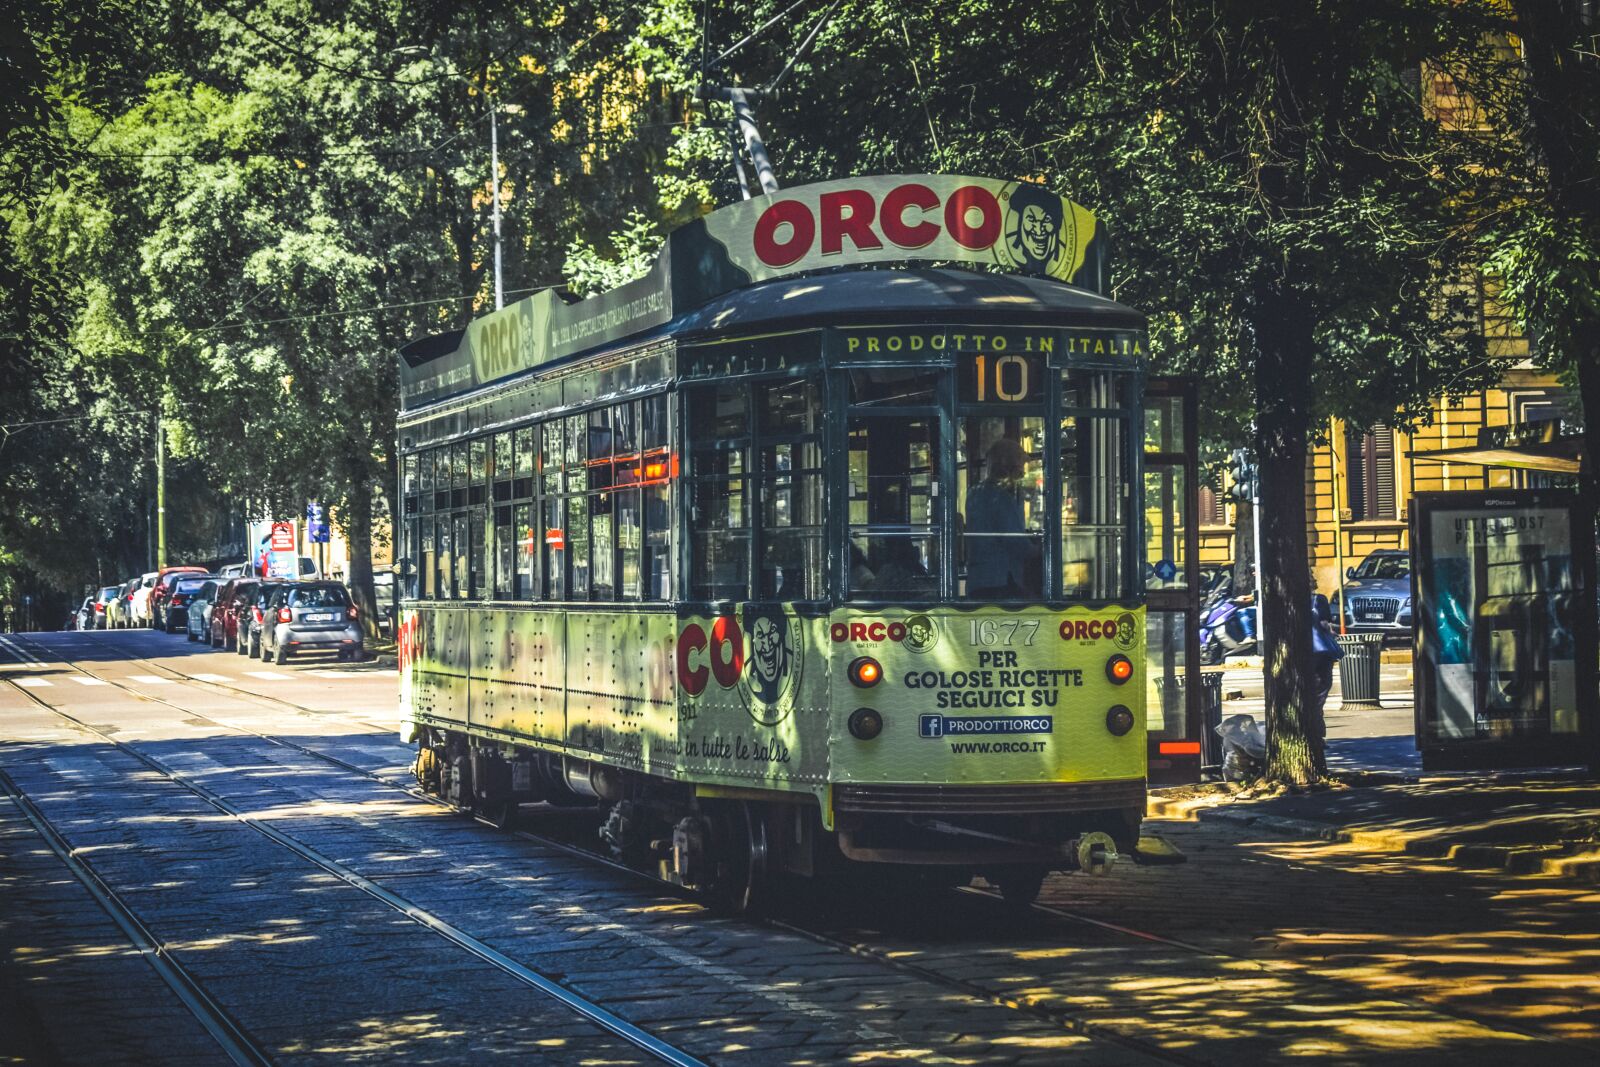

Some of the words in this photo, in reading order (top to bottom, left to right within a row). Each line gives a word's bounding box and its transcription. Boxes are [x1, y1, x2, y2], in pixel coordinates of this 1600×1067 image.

[753, 183, 1002, 269] ORCO
[579, 312, 607, 338] SPECIALISTA
[607, 304, 631, 329] ITALIANO
[632, 297, 647, 319] DELLE
[647, 291, 664, 313] SALSE
[480, 312, 520, 378] ORCO
[848, 335, 1008, 353] PRODOTTO
[1025, 336, 1053, 352] IN
[1069, 338, 1143, 355] ITALIA
[975, 355, 1029, 401] 10
[830, 621, 907, 643] ORCO
[969, 619, 1040, 646] 1677
[1059, 620, 1117, 640] ORCO
[978, 650, 1018, 667] PER
[904, 671, 993, 689] GOLOSE
[999, 670, 1083, 687] RICETTE
[937, 690, 1025, 708] SEGUICI
[1031, 690, 1059, 706] SU
[949, 719, 1050, 731] PRODOTTIORCO
[686, 736, 699, 756] in
[702, 735, 732, 758] tutte
[735, 735, 750, 760] le
[752, 737, 791, 763] salse
[951, 741, 1046, 753] WWW.ORCO.IT
